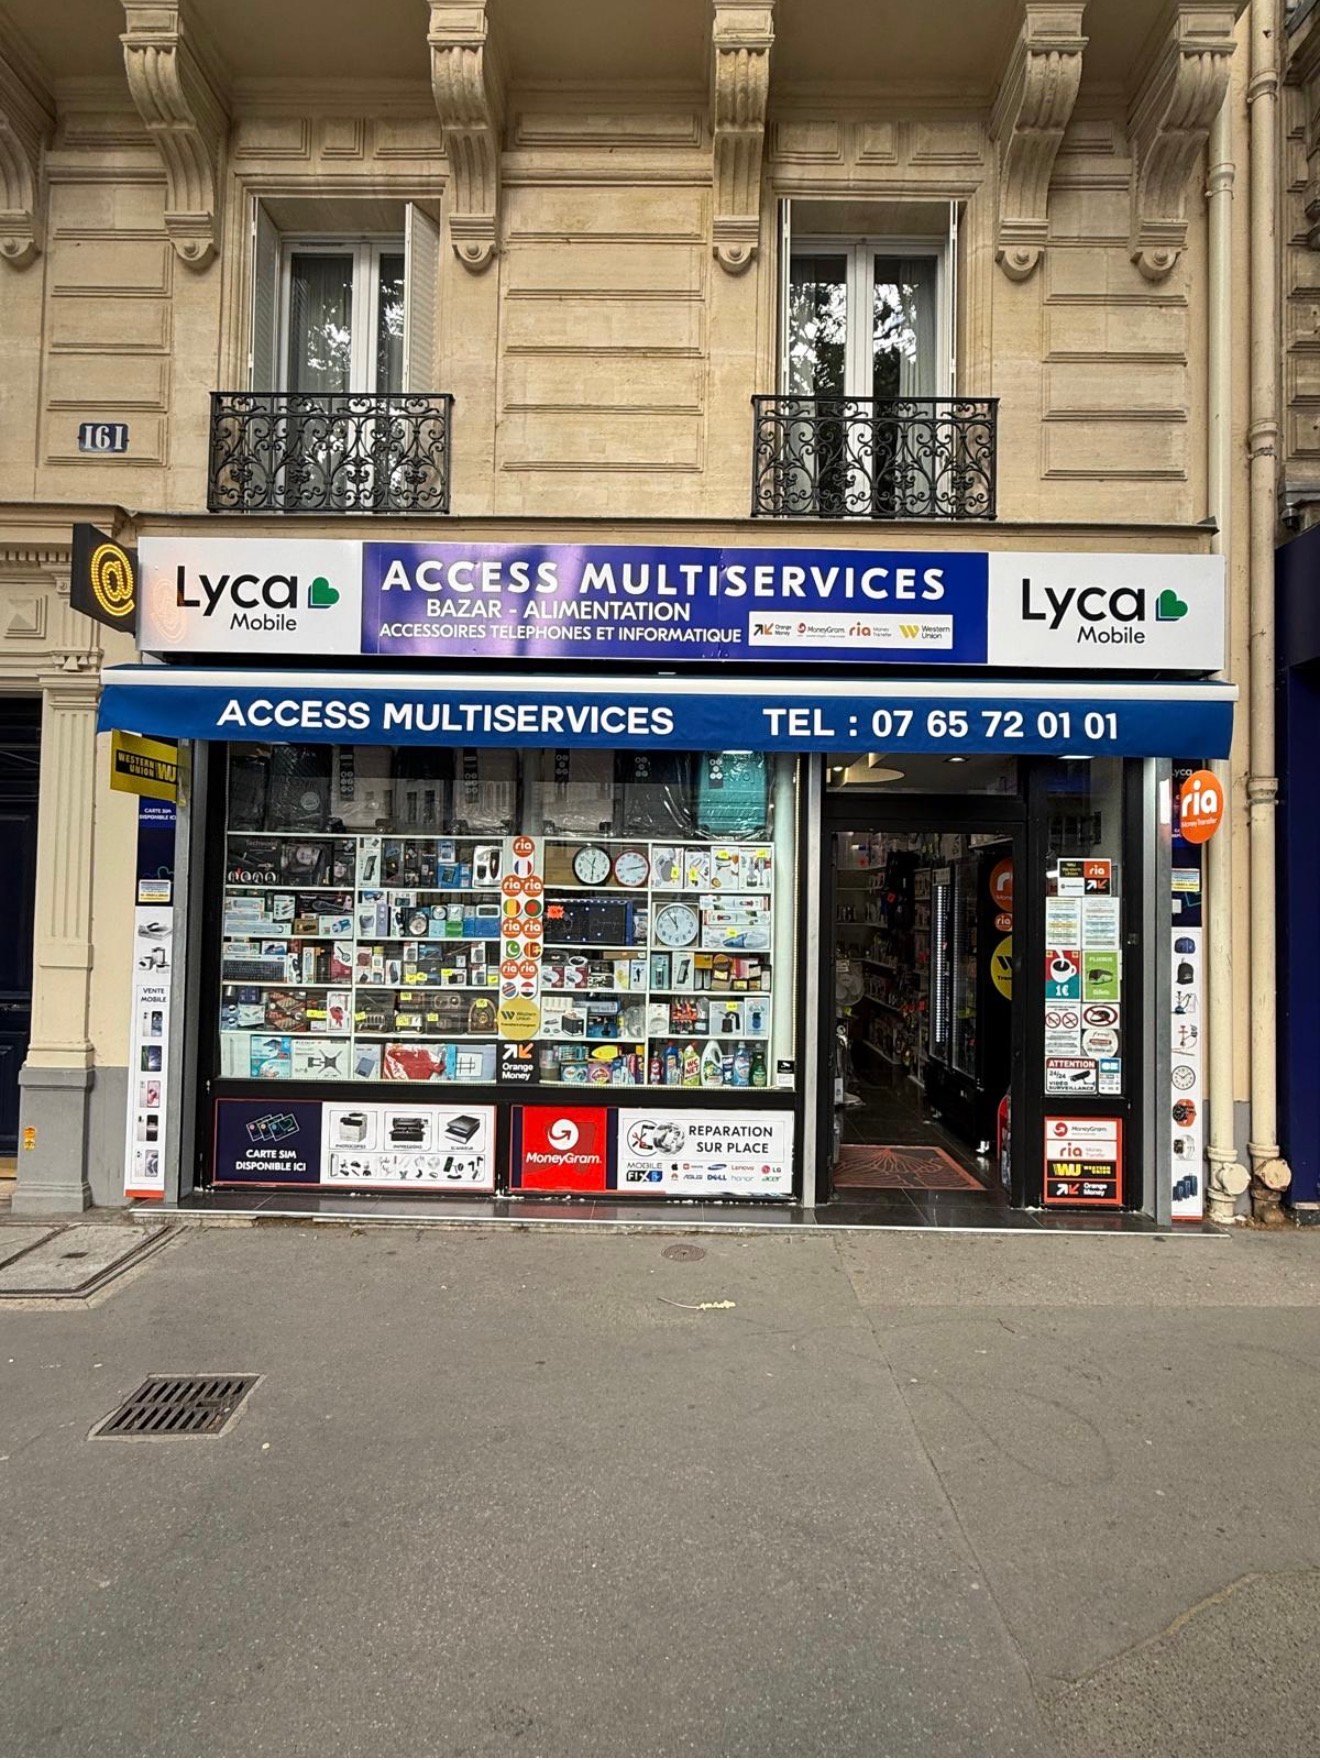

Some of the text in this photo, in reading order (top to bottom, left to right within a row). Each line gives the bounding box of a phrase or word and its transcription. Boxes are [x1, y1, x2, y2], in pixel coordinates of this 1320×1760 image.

[84, 425, 124, 450] 161
[381, 560, 946, 601] ACCESS MULTISERVICES
[176, 565, 298, 617] Lyca
[426, 598, 502, 619] BAZAR
[523, 600, 691, 622] ALIMENTATION
[1022, 578, 1146, 630] Lyca
[229, 613, 298, 631] Mobile
[379, 623, 742, 644] ACCESSOIRES TELEPHONES ET INFORMATIQUE
[806, 626, 846, 635] MoneyGram
[849, 621, 872, 637] ria
[921, 625, 951, 633] Western
[1076, 625, 1146, 644] Mobile
[921, 632, 943, 640] Union
[216, 699, 675, 736] ACCESS MULTISERVICES
[762, 708, 835, 737] TEL
[871, 709, 913, 737] 07
[926, 709, 970, 738] 65
[981, 710, 1025, 739] 72
[1036, 711, 1072, 739] 01
[1083, 712, 1119, 740] 01
[118, 752, 155, 769] WESTERN
[129, 764, 154, 778] UNION
[1173, 767, 1193, 778] yca
[1181, 779, 1218, 818] ria
[515, 839, 532, 850] ria
[1089, 865, 1105, 875] ria
[504, 878, 520, 889] ria
[524, 879, 542, 890] ria
[503, 920, 520, 931] ria
[524, 920, 541, 932] ria
[502, 962, 518, 973] ria
[520, 962, 536, 973] ria
[142, 987, 165, 995] VENTE
[1055, 984, 1070, 997] 1€
[501, 1062, 534, 1072] Orange
[1048, 1060, 1096, 1068] ATTENTION
[501, 1071, 531, 1081] Money
[688, 1125, 773, 1138] REPARATION
[245, 1149, 297, 1159] CARTE SIM
[696, 1141, 769, 1154] SUR PLACE
[1060, 1142, 1083, 1157] ria
[525, 1151, 601, 1165] MoneyGram
[235, 1161, 307, 1172] DISPONIBLE ICI
[1053, 1163, 1081, 1176] WU
[707, 1174, 728, 1182] DELL
